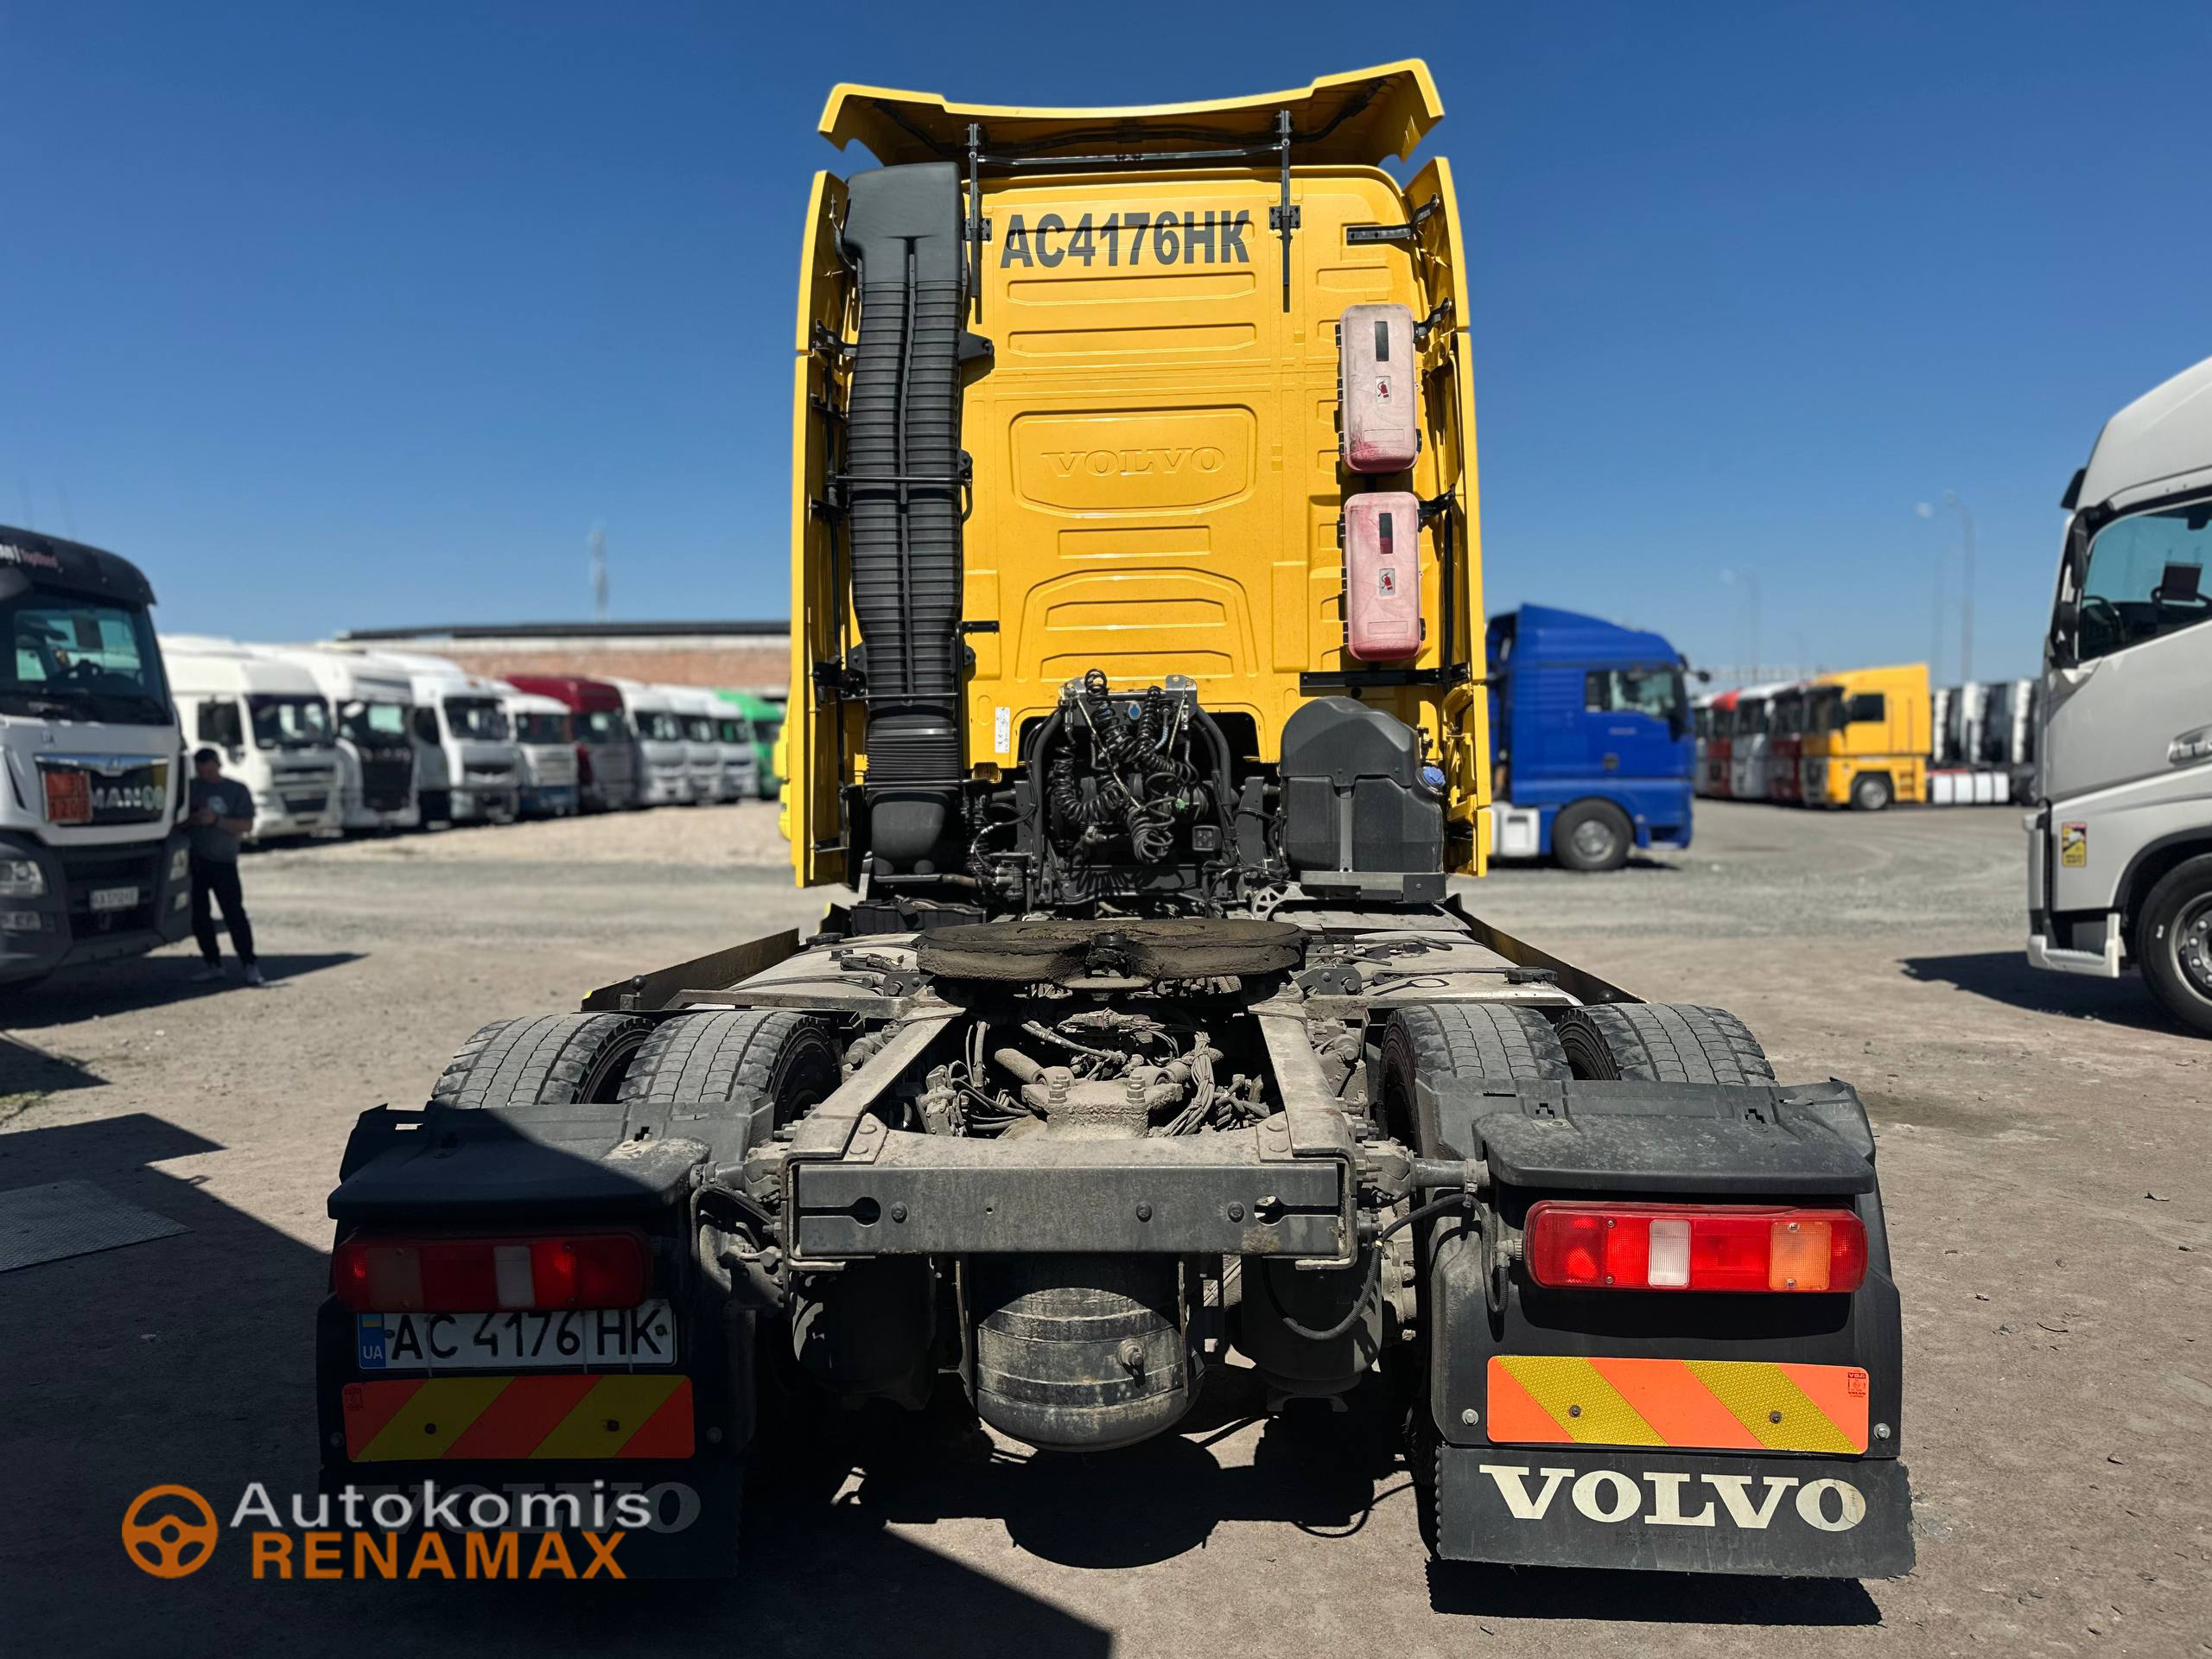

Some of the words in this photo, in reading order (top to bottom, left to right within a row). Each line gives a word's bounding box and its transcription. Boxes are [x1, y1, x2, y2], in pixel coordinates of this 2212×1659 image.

[1000, 209, 1249, 269] AC4176HK
[1040, 446, 1224, 477] VOLVO
[363, 1346, 383, 1359] UA
[391, 1314, 459, 1361] AC
[473, 1313, 582, 1357] 4176
[596, 1308, 663, 1356] HK
[1479, 1465, 1866, 1532] VOLVO
